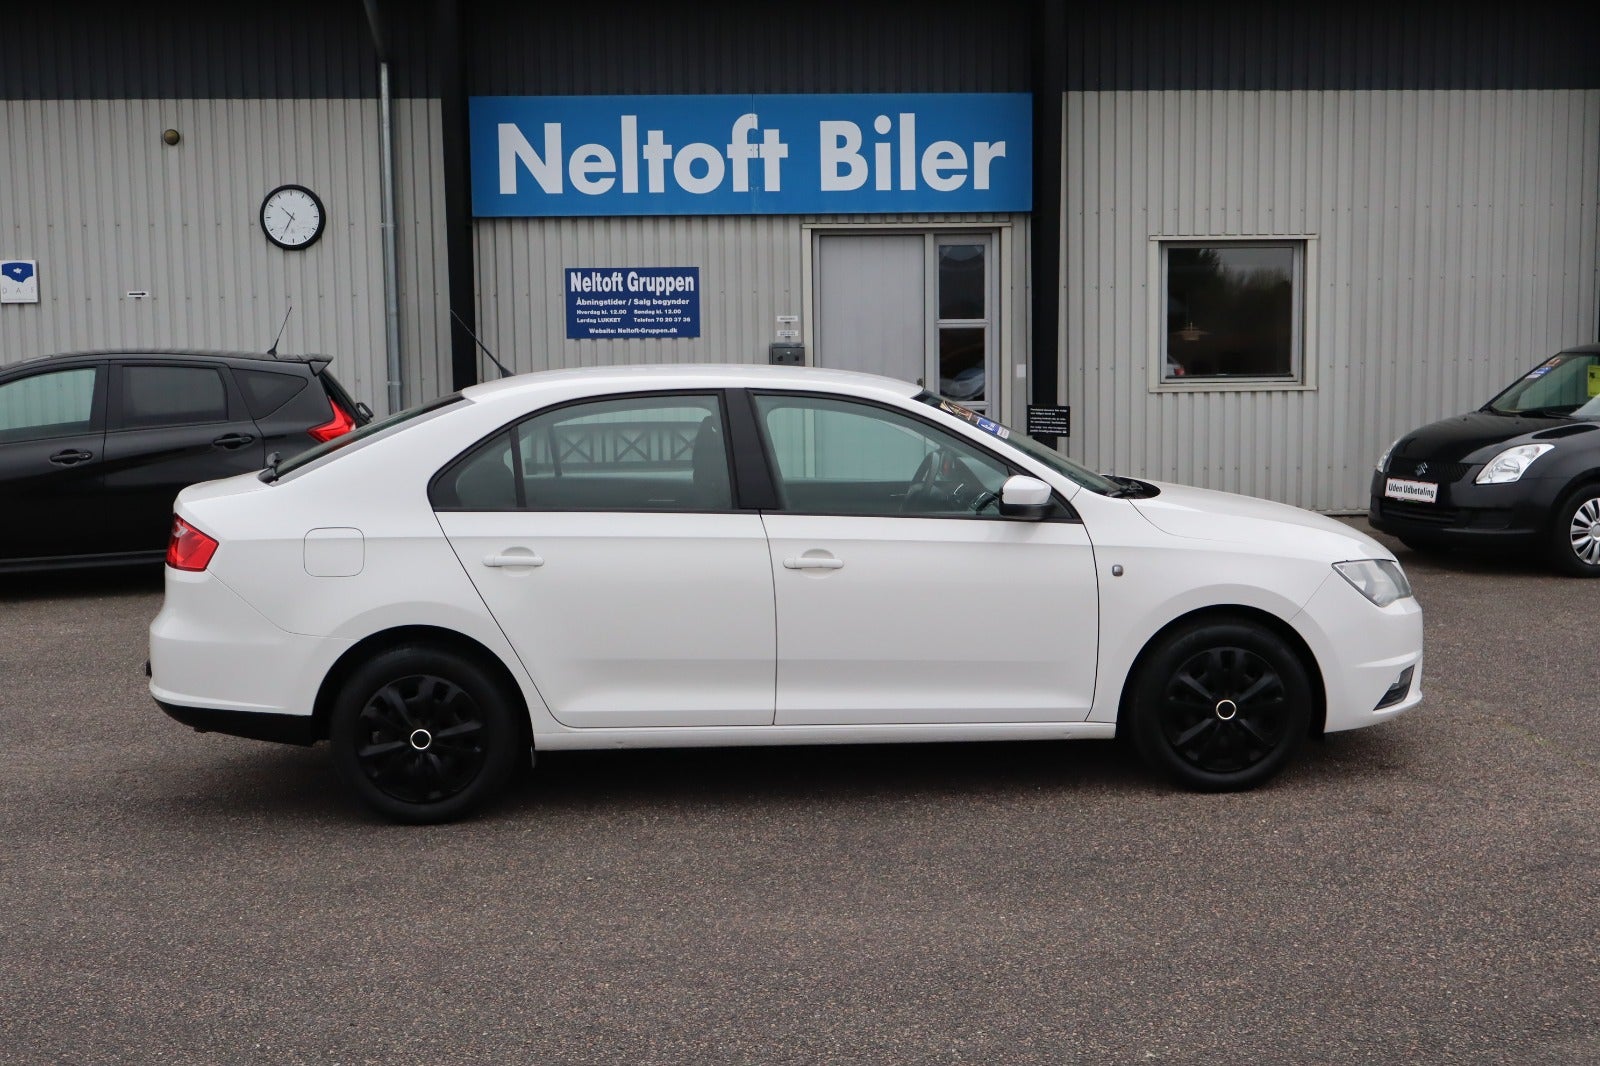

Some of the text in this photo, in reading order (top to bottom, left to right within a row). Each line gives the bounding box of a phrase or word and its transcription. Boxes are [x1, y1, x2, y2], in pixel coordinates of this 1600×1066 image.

[497, 113, 1006, 195] Neltoft Biler
[570, 271, 694, 296] Neltoft Gruppen
[576, 297, 690, 307] Åbningstider / Salg begynder
[1388, 483, 1435, 498] Uden Udbetaling
